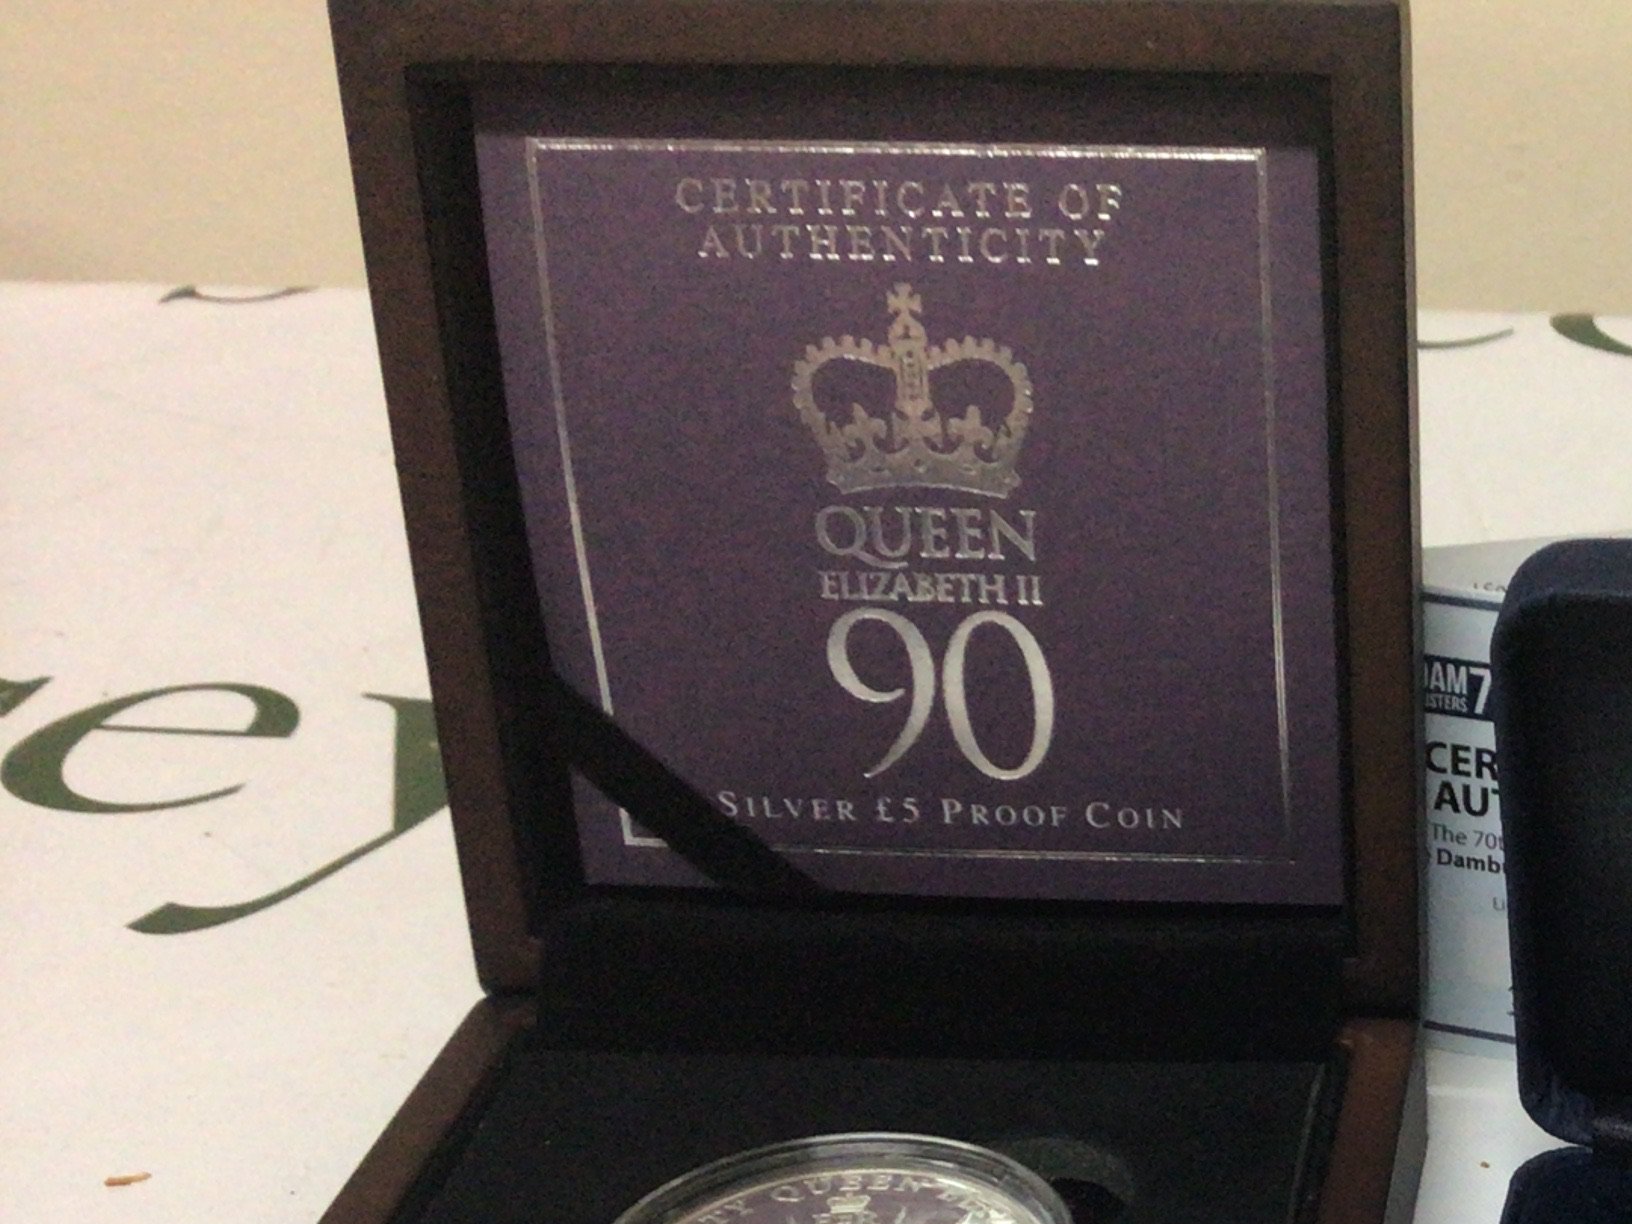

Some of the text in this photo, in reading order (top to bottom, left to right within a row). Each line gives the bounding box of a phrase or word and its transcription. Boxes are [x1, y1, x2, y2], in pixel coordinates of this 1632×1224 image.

[675, 178, 1124, 221] CERTIFICATE OF
[697, 224, 1110, 266] AUTHENTICITY
[813, 505, 1037, 568] QUEEN
[819, 570, 1044, 606] ELIZABETH II
[825, 605, 1055, 781] 90
[1424, 661, 1468, 696] AM
[717, 789, 1185, 831] SILVER £5 PROOF COIN
[1432, 823, 1468, 846] The
